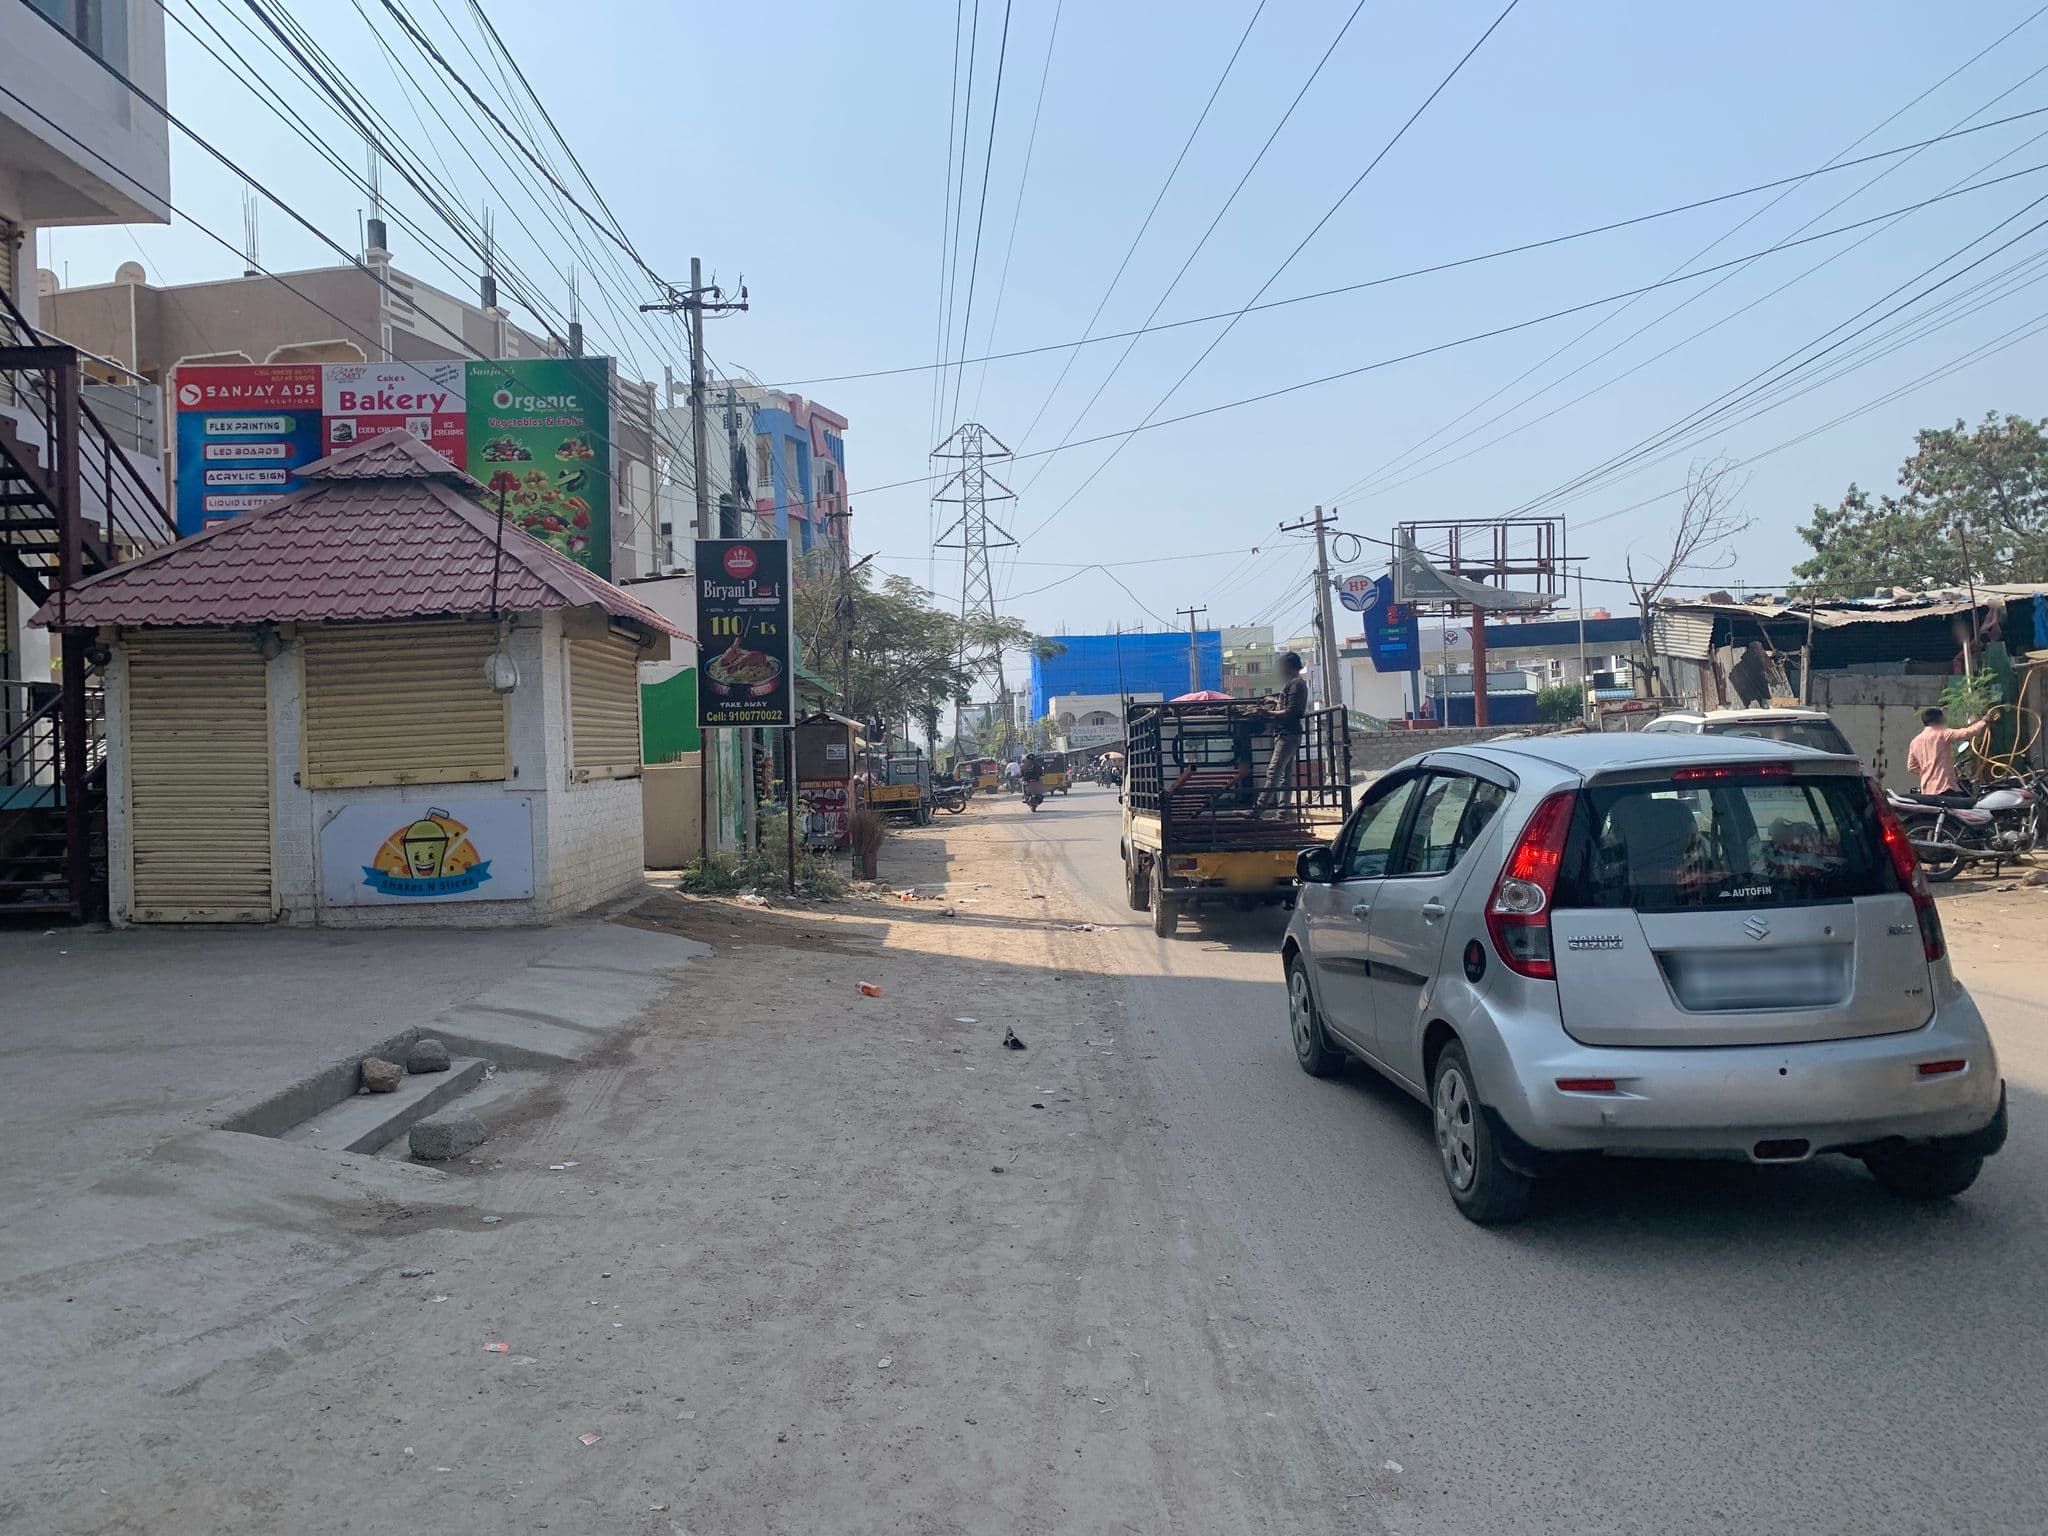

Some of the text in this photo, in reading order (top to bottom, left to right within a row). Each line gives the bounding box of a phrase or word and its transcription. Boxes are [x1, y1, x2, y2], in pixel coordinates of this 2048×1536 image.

[206, 384, 315, 397] SANJAY ADS
[340, 390, 448, 413] Bakery
[493, 389, 577, 412] Organic
[209, 422, 280, 431] FLEX PRINTING
[545, 416, 554, 427] &
[213, 447, 280, 456] LED BOARDS
[207, 472, 284, 481] ACRYLIC SIGN
[208, 499, 240, 507] LIQUID
[703, 580, 745, 600] Biryani
[1348, 580, 1368, 592] HP
[706, 710, 783, 721] Cell: 9100770022
[428, 881, 435, 891] N
[1732, 886, 1772, 897] AUTOFIN
[1568, 934, 1623, 942] MARUTI
[1568, 941, 1624, 950] SUZUKI
